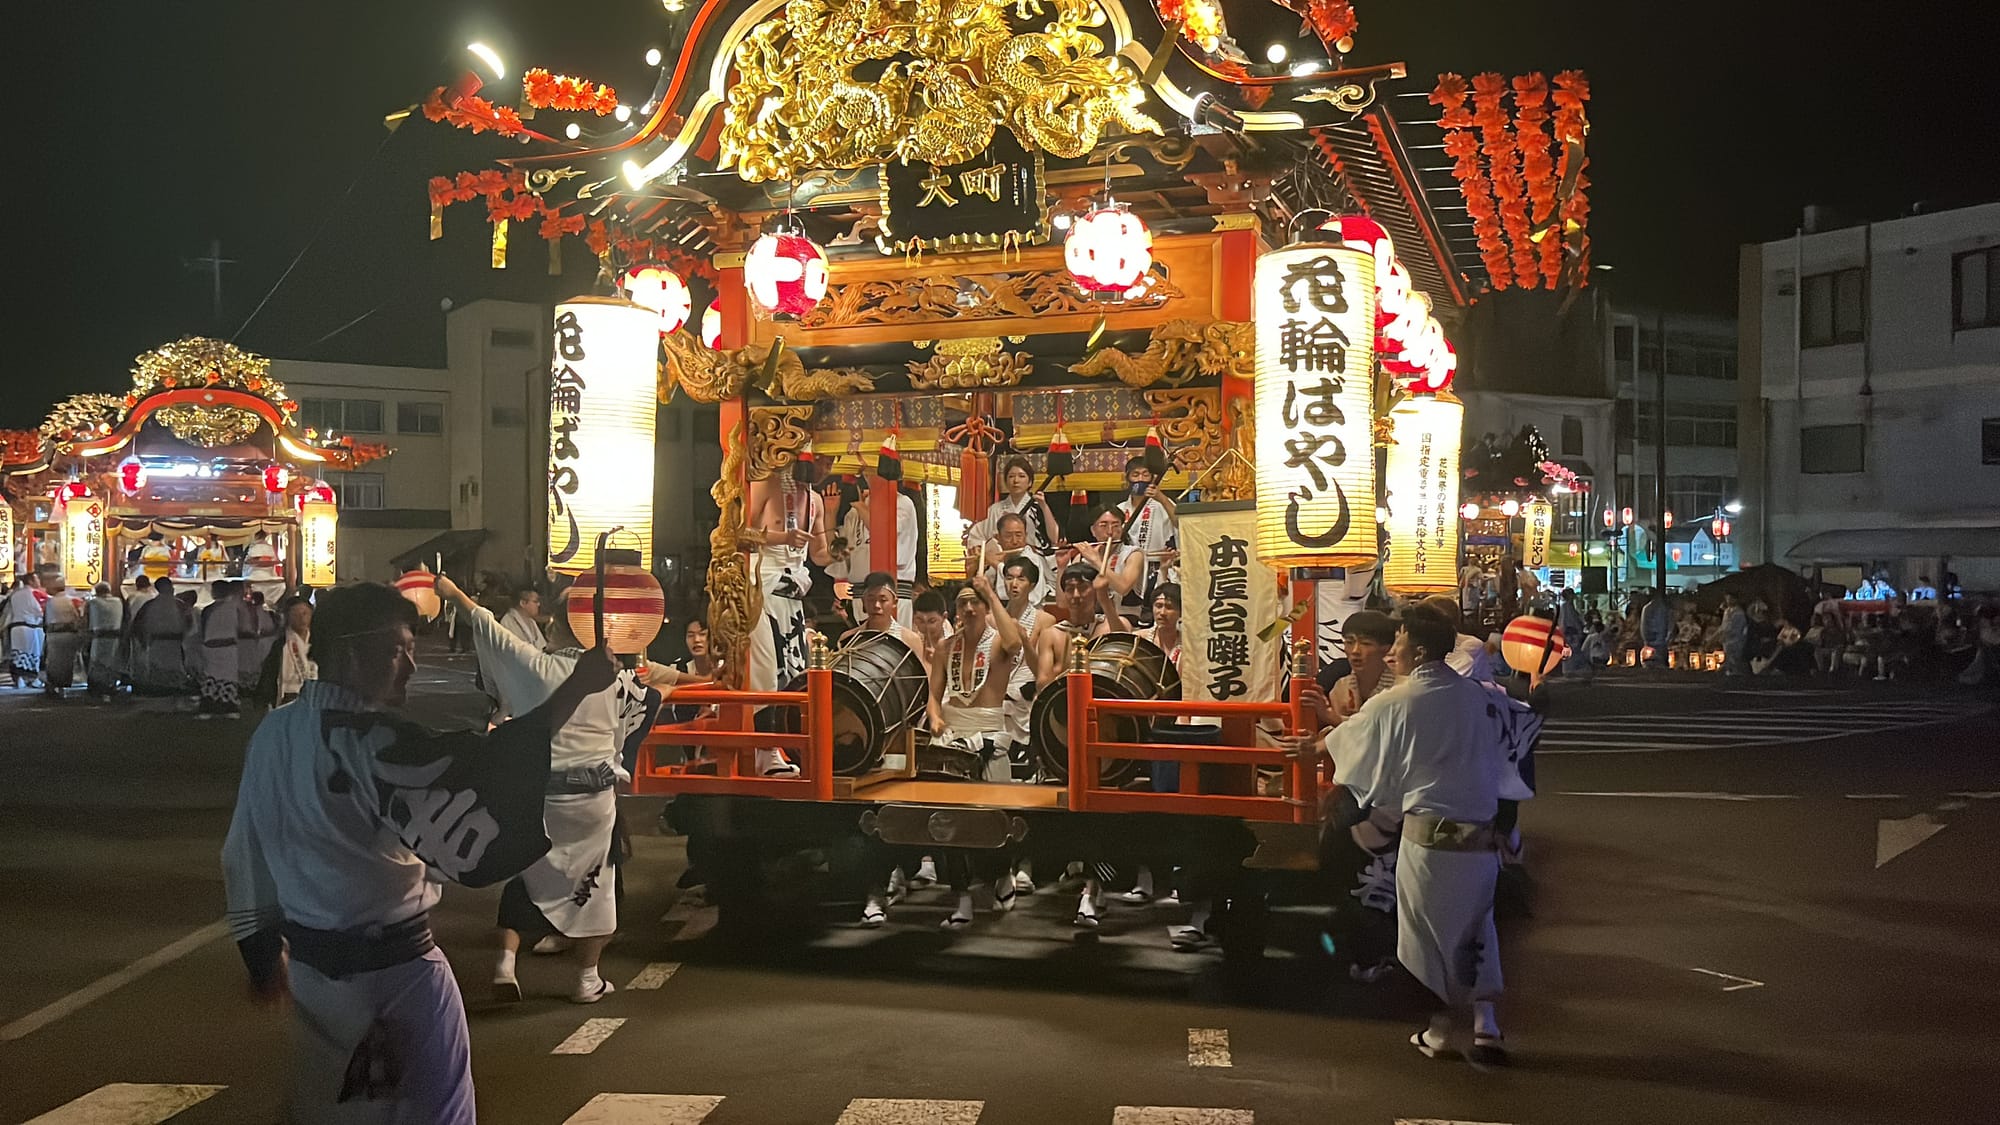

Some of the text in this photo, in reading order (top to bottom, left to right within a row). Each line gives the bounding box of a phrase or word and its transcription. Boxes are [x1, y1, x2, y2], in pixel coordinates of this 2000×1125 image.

[916, 163, 1007, 208] 大町
[550, 311, 586, 564] 花輪ばやし
[1279, 255, 1351, 549] 花輪ばやし
[1207, 535, 1251, 700] 本屋台囃子
